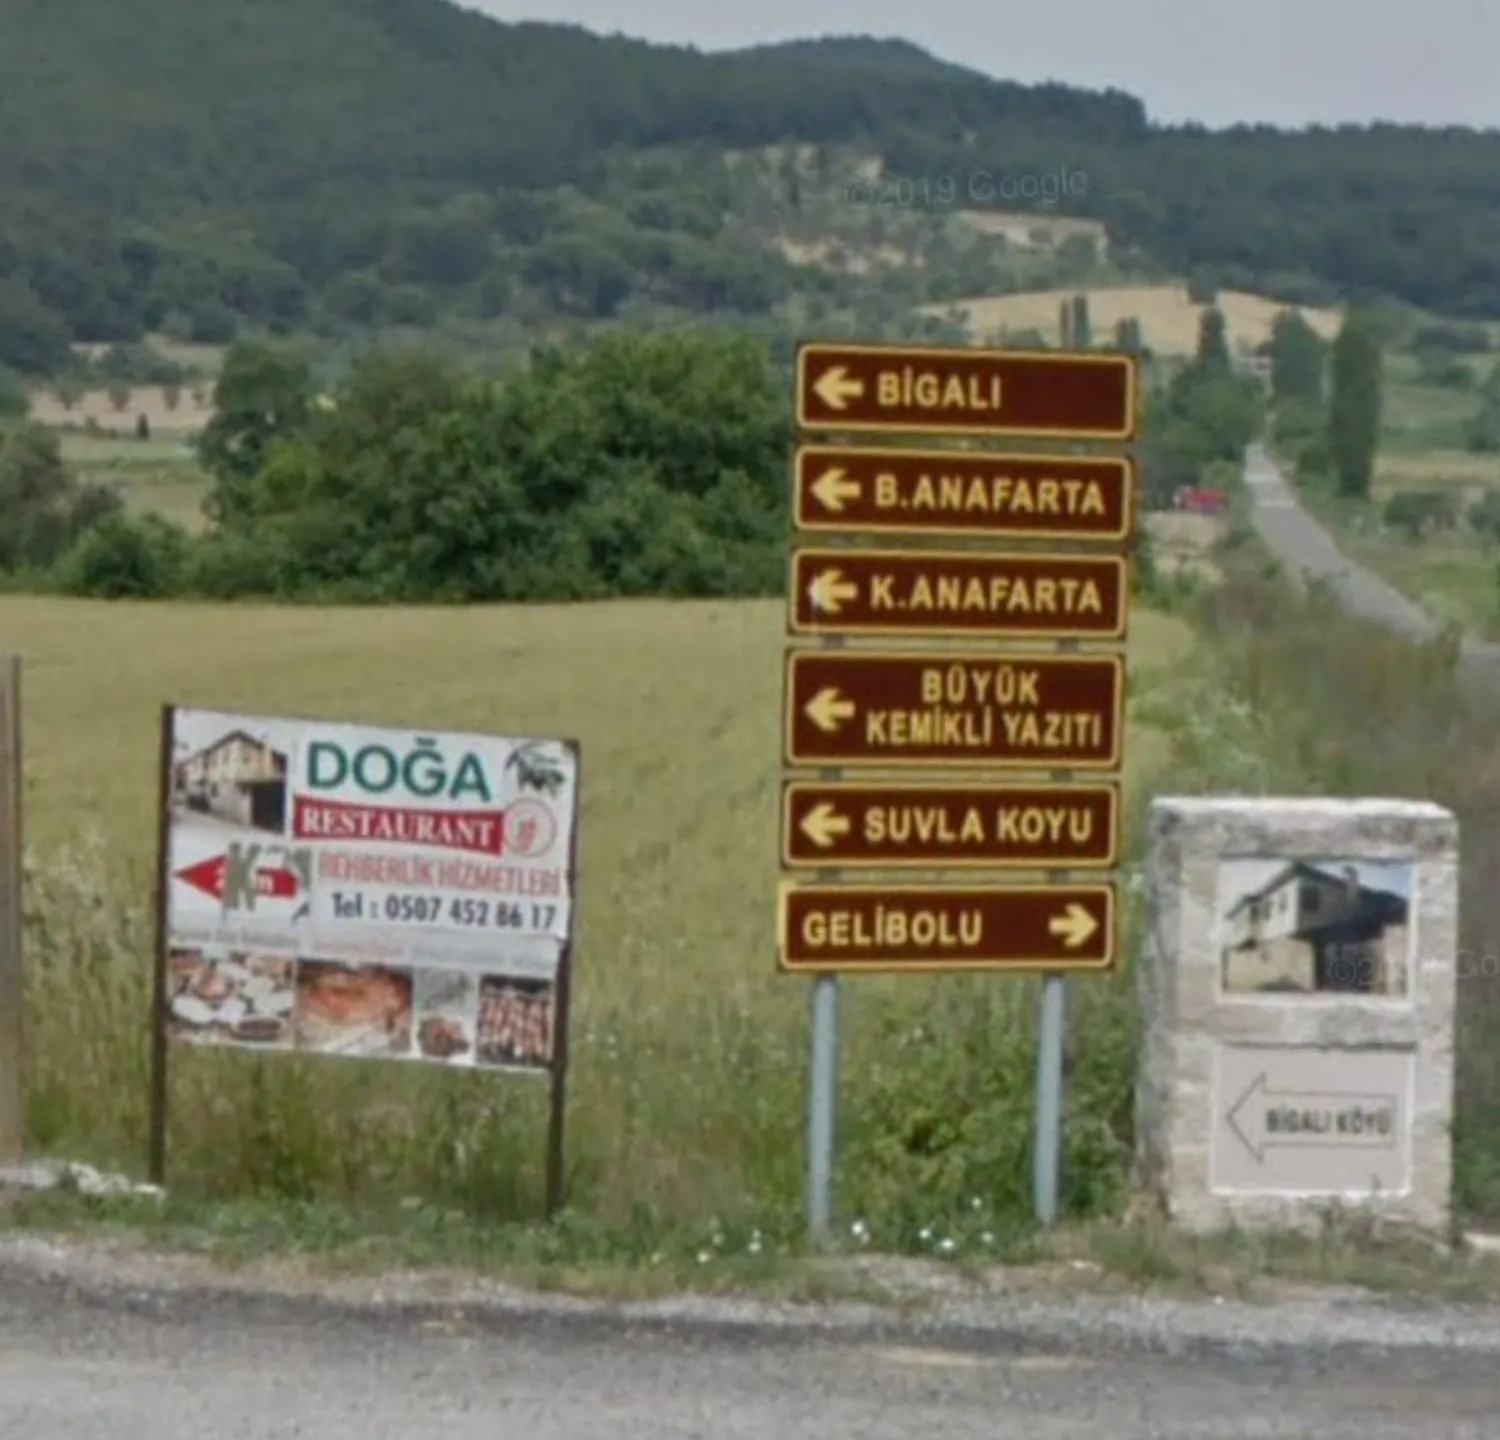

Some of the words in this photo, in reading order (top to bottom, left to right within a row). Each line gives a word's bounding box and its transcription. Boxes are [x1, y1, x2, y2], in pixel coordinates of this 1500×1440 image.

[876, 366, 1002, 409] BİGALI
[875, 473, 1105, 516] B.ANAFARTA
[871, 575, 1102, 614] K.ANAFARTA
[921, 664, 1040, 705] BÜYÜK
[866, 706, 993, 746] KEMİKLİ
[1003, 713, 1100, 748] YAZITI
[306, 737, 492, 802] DOĞA
[299, 806, 494, 848] RESTAURANT
[864, 805, 985, 842] SUVLA
[998, 808, 1093, 842] KOYU
[331, 892, 362, 918] Tel
[384, 894, 442, 921] 0507
[449, 897, 489, 927] 452
[531, 904, 557, 929] 17
[802, 901, 983, 946] GELİBOLU
[1266, 1105, 1330, 1134] BİGALI
[1336, 1105, 1392, 1135] KÖYÜ
